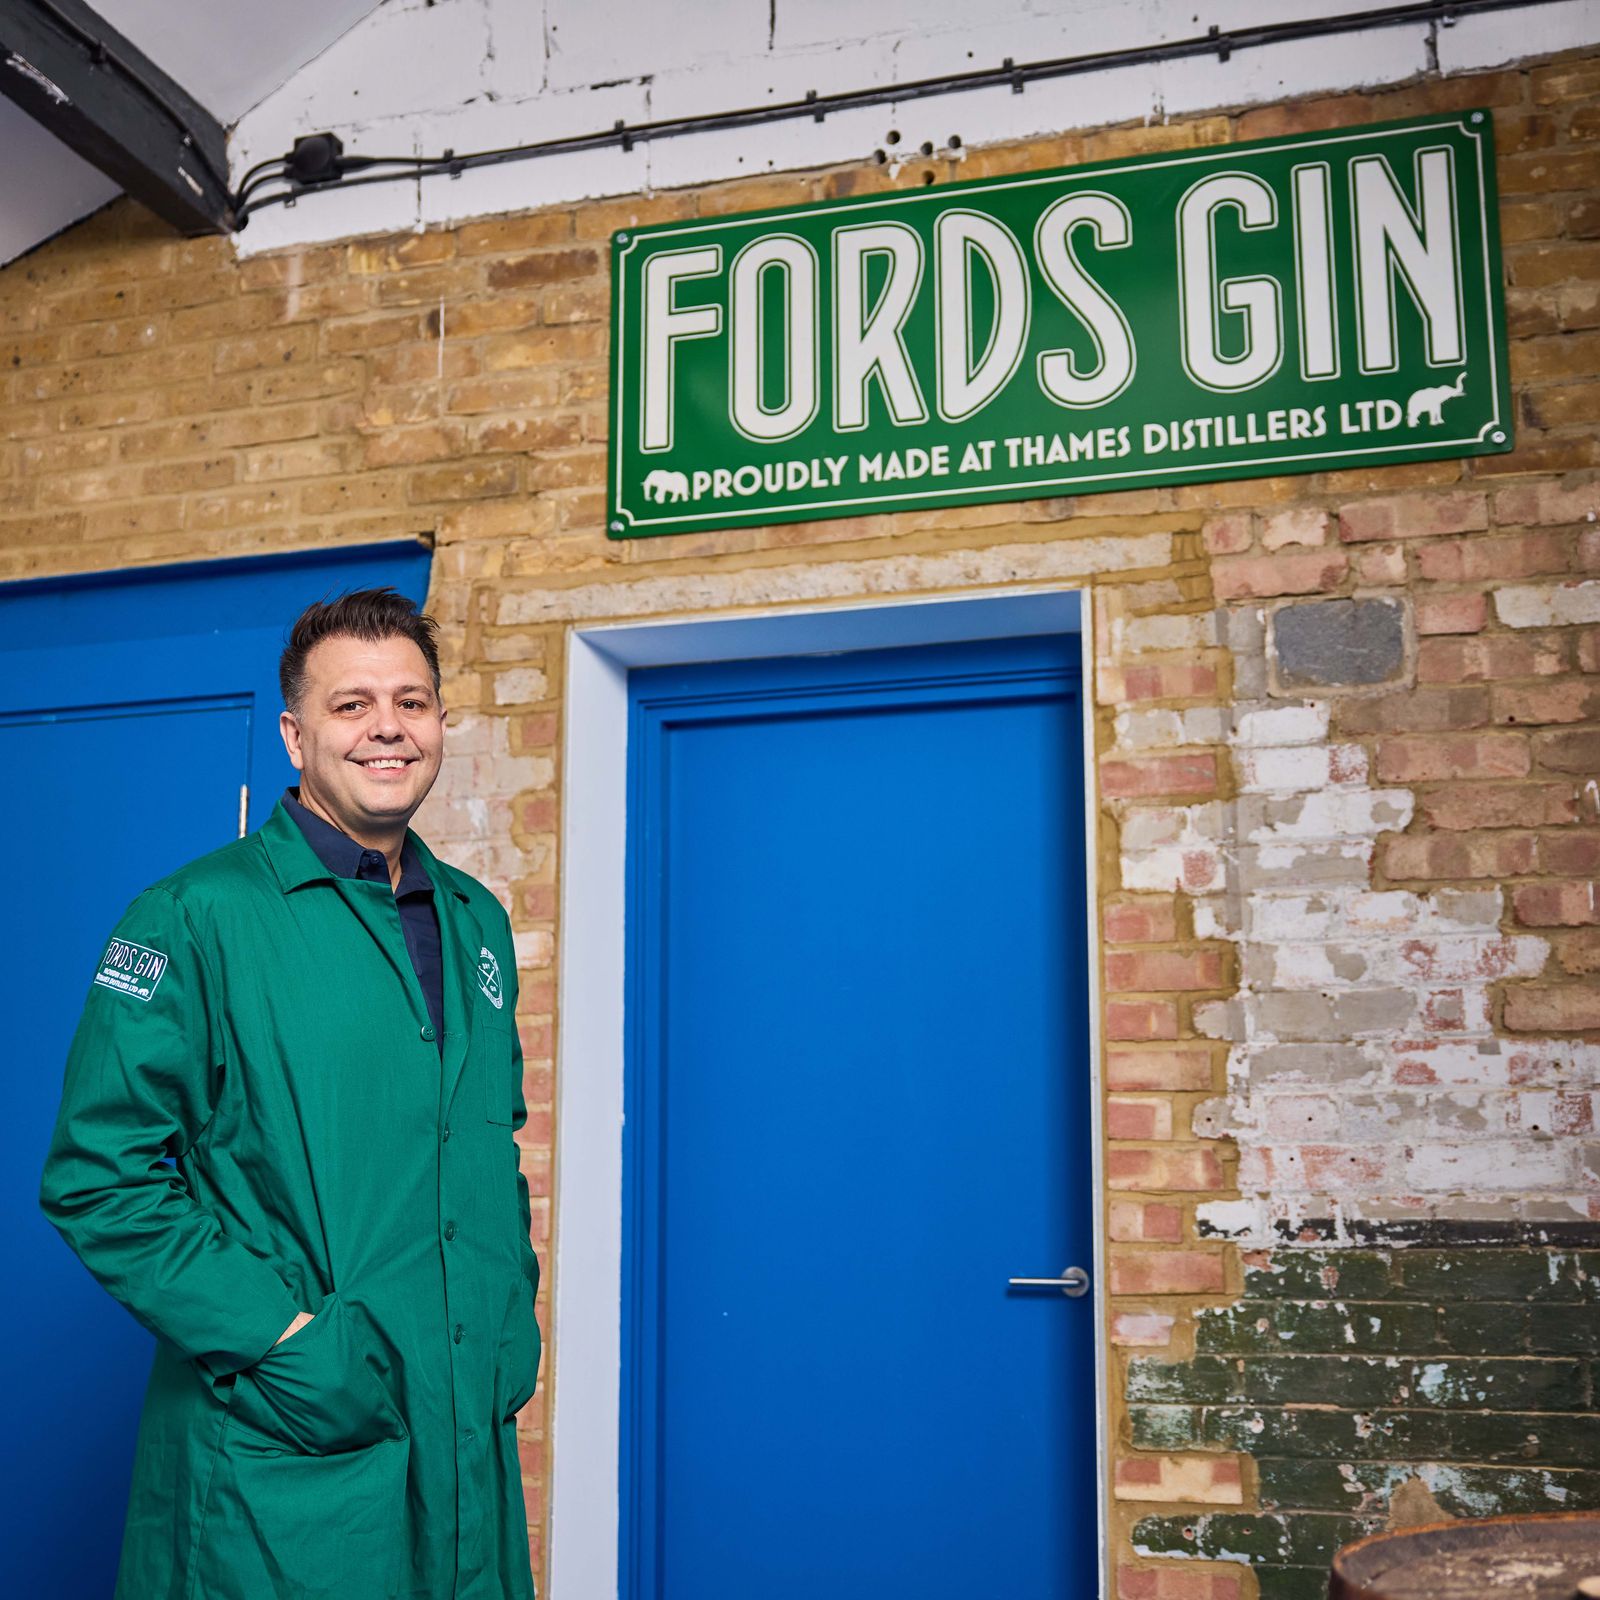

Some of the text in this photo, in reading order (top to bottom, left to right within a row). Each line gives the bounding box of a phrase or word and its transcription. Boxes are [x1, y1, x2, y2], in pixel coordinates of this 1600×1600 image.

[639, 144, 1467, 455] FORDS GIN
[692, 399, 1403, 500] PROUDLY MADE AT THAMES DISTILLERS LTD
[133, 951, 164, 981] GIN
